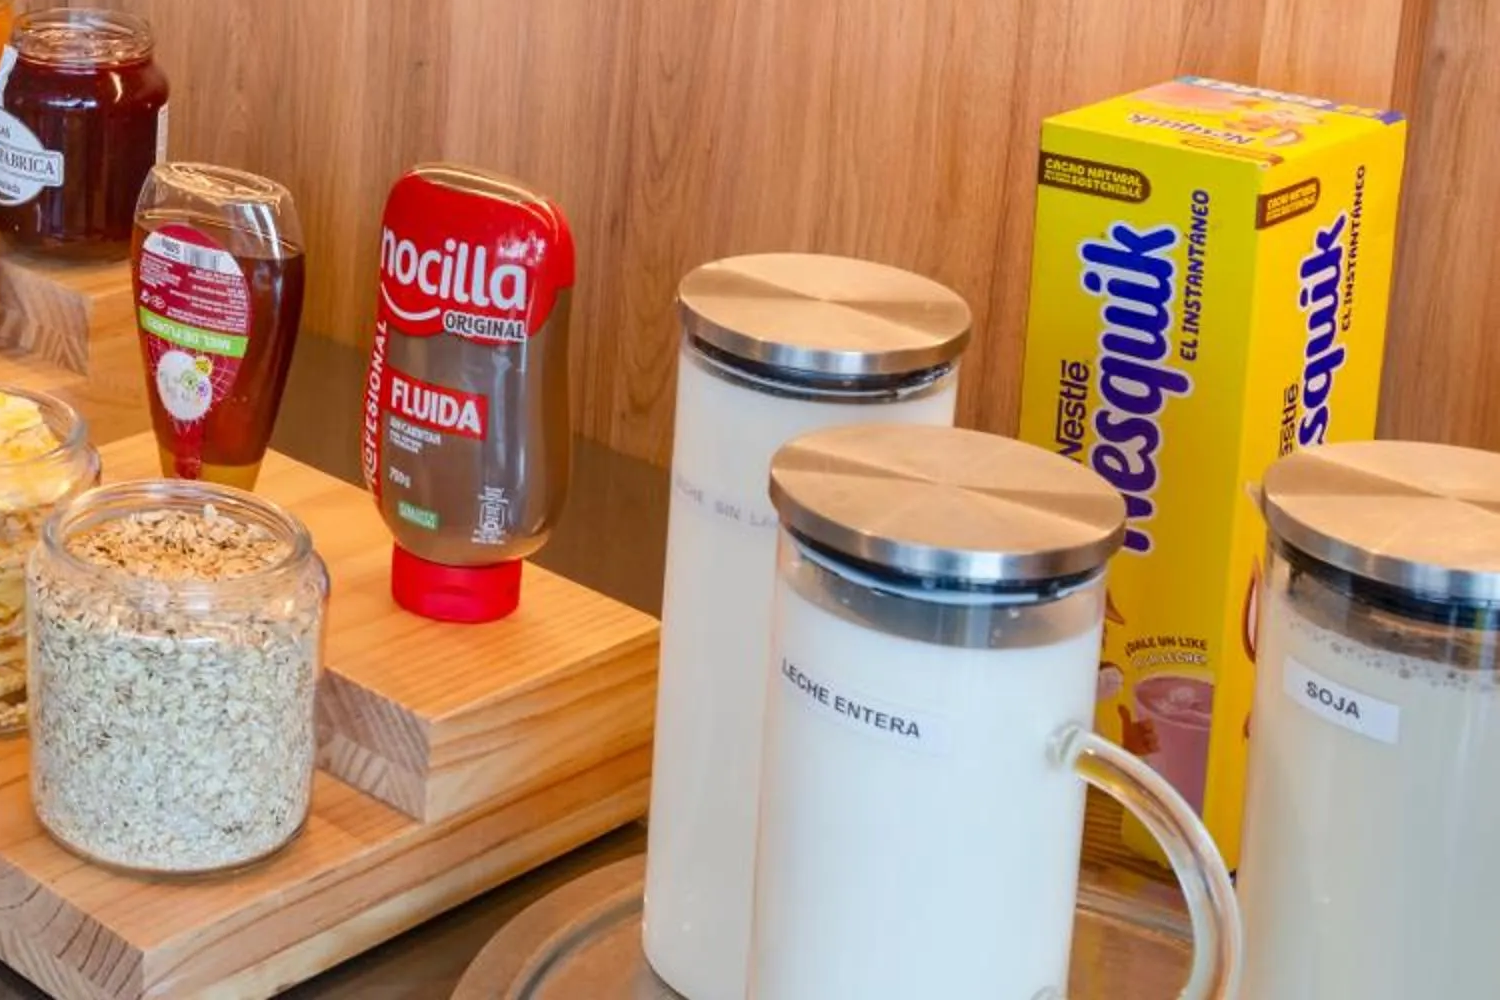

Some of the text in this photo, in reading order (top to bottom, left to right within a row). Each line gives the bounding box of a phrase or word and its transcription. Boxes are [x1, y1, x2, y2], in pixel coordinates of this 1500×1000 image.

[1045, 158, 1085, 176] CACAO
[1087, 168, 1142, 188] NATURAL
[380, 225, 527, 312] nocilla
[1180, 189, 1210, 361] EL INSTANTÁNEO
[444, 313, 526, 340] ORIGINAL
[390, 376, 481, 434] FLUIDA
[781, 658, 921, 738] LECHE ENTERA
[1306, 680, 1361, 719] SOJA
